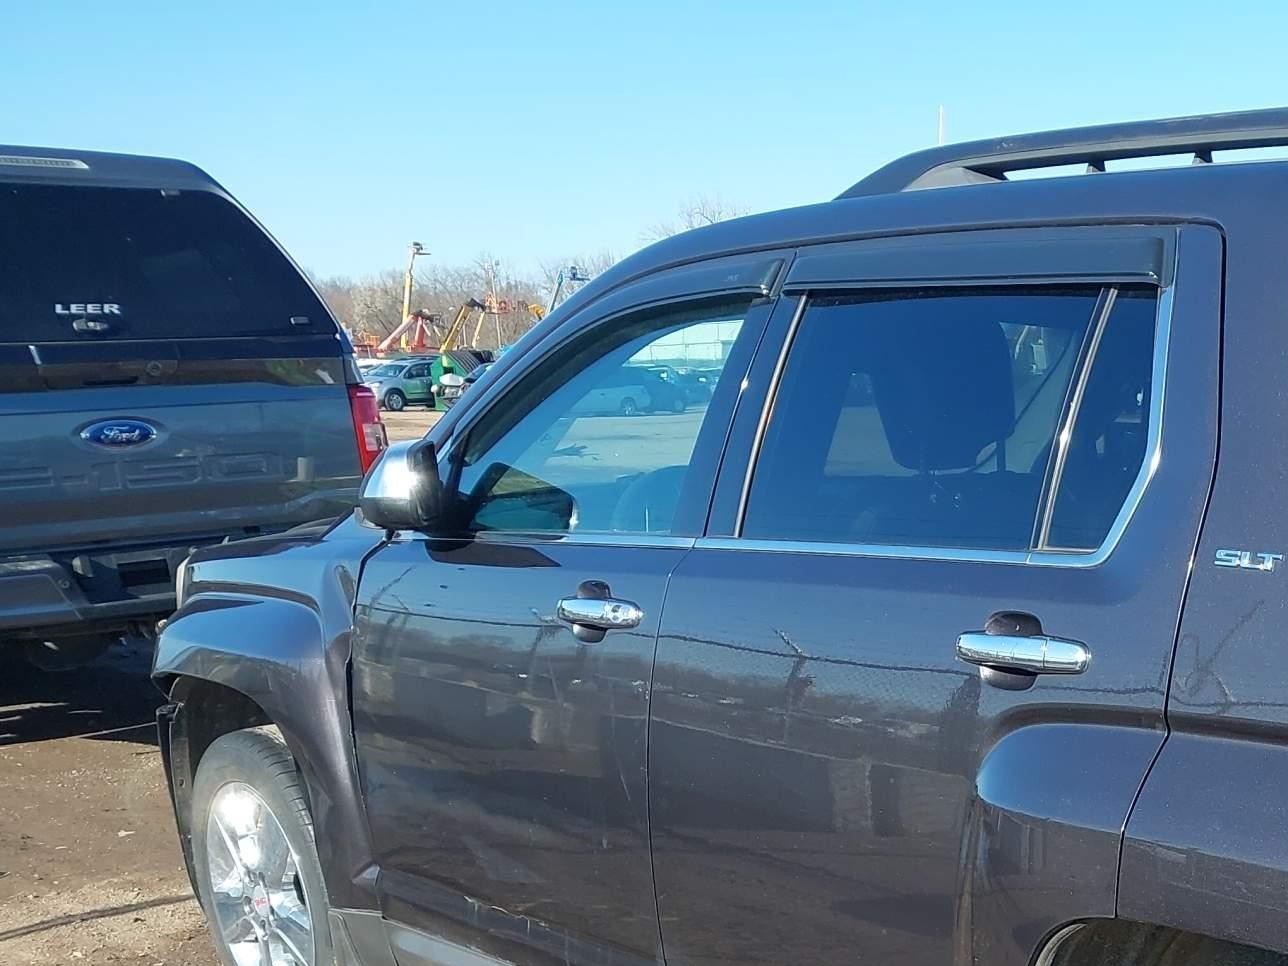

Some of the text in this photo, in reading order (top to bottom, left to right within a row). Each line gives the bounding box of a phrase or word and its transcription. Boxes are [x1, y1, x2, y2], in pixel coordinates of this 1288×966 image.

[54, 302, 122, 315] LEER
[101, 425, 141, 442] Ford
[1213, 549, 1284, 572] SLT
